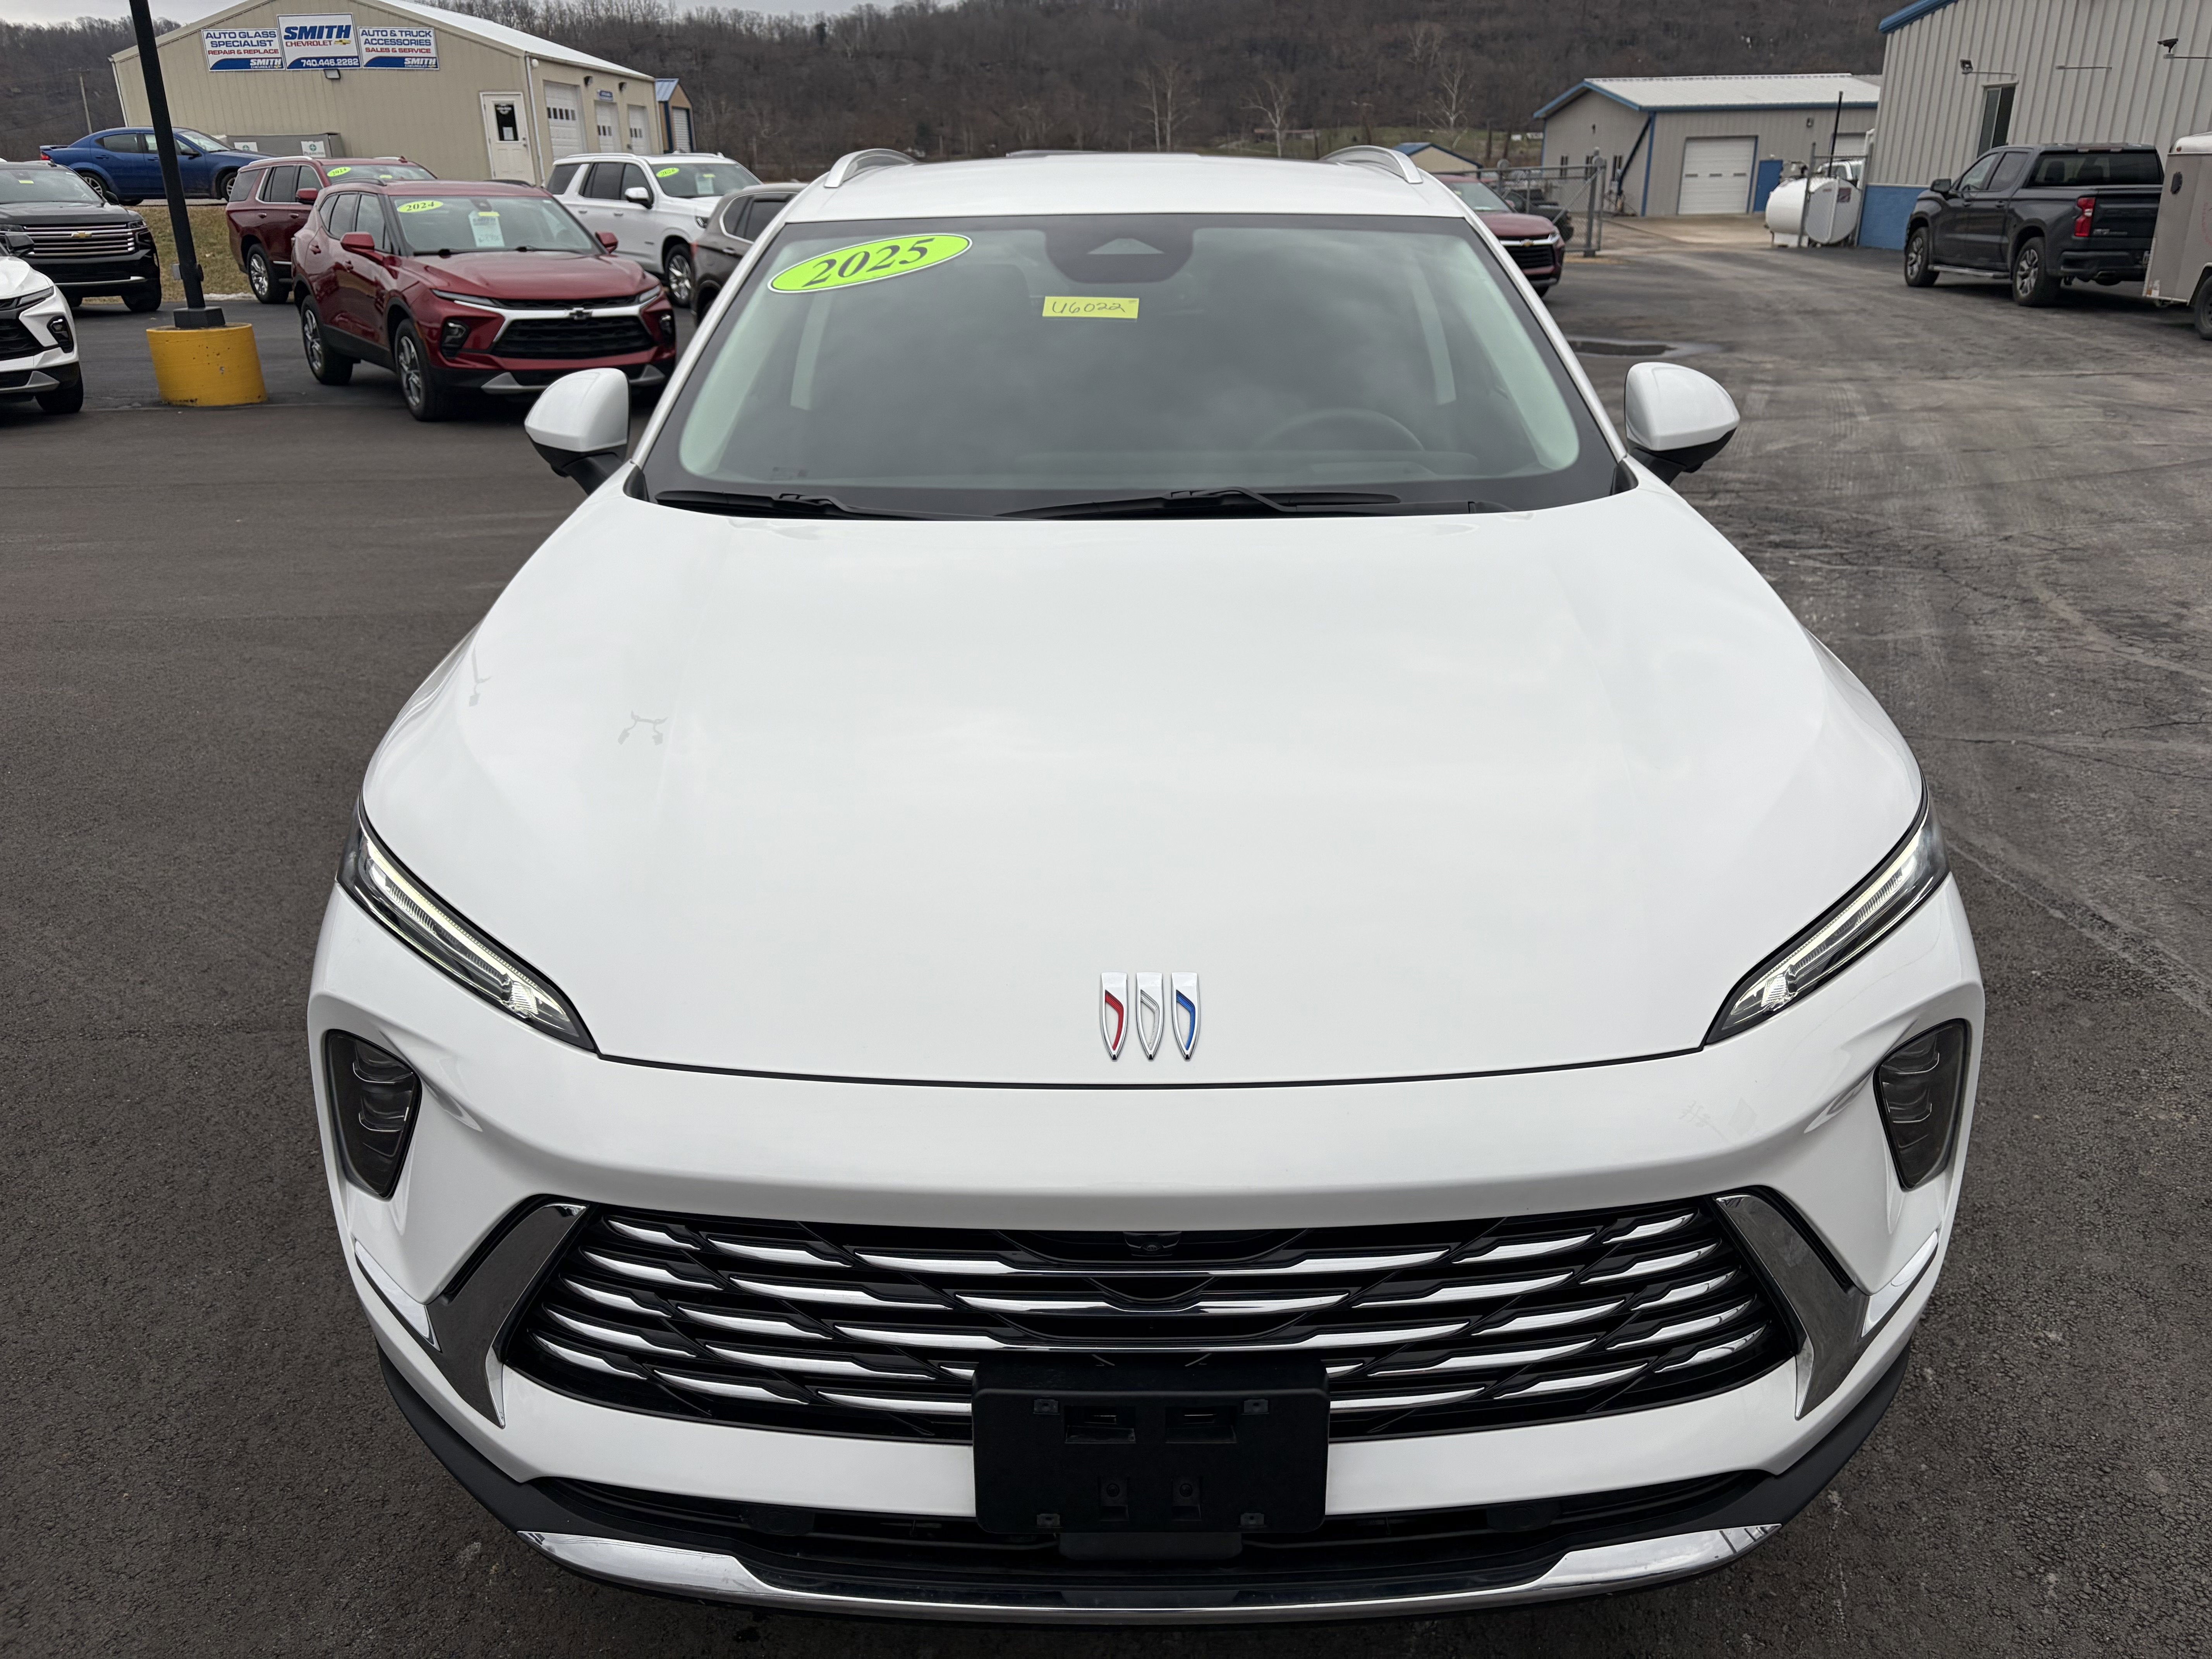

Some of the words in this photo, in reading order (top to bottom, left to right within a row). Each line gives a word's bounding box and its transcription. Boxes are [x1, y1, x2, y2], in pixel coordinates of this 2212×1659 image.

[283, 24, 351, 40] SMITH
[406, 201, 434, 211] 2024
[801, 237, 935, 287] 2025
